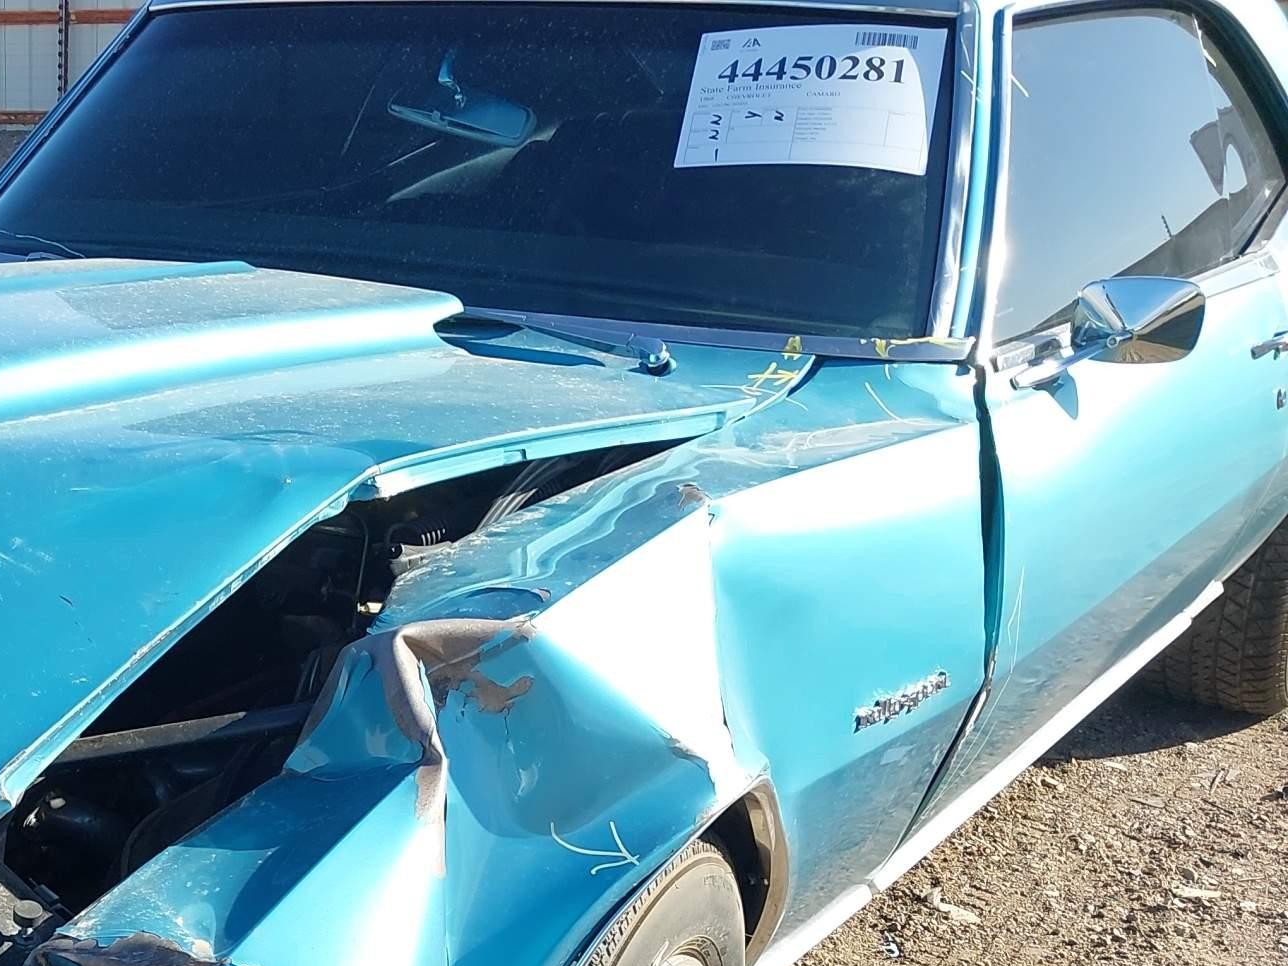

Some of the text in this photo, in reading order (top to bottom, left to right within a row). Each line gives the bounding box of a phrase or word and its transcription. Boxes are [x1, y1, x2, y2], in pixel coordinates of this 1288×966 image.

[718, 55, 905, 84] 44450281
[700, 82, 802, 95] State Farm Insurance
